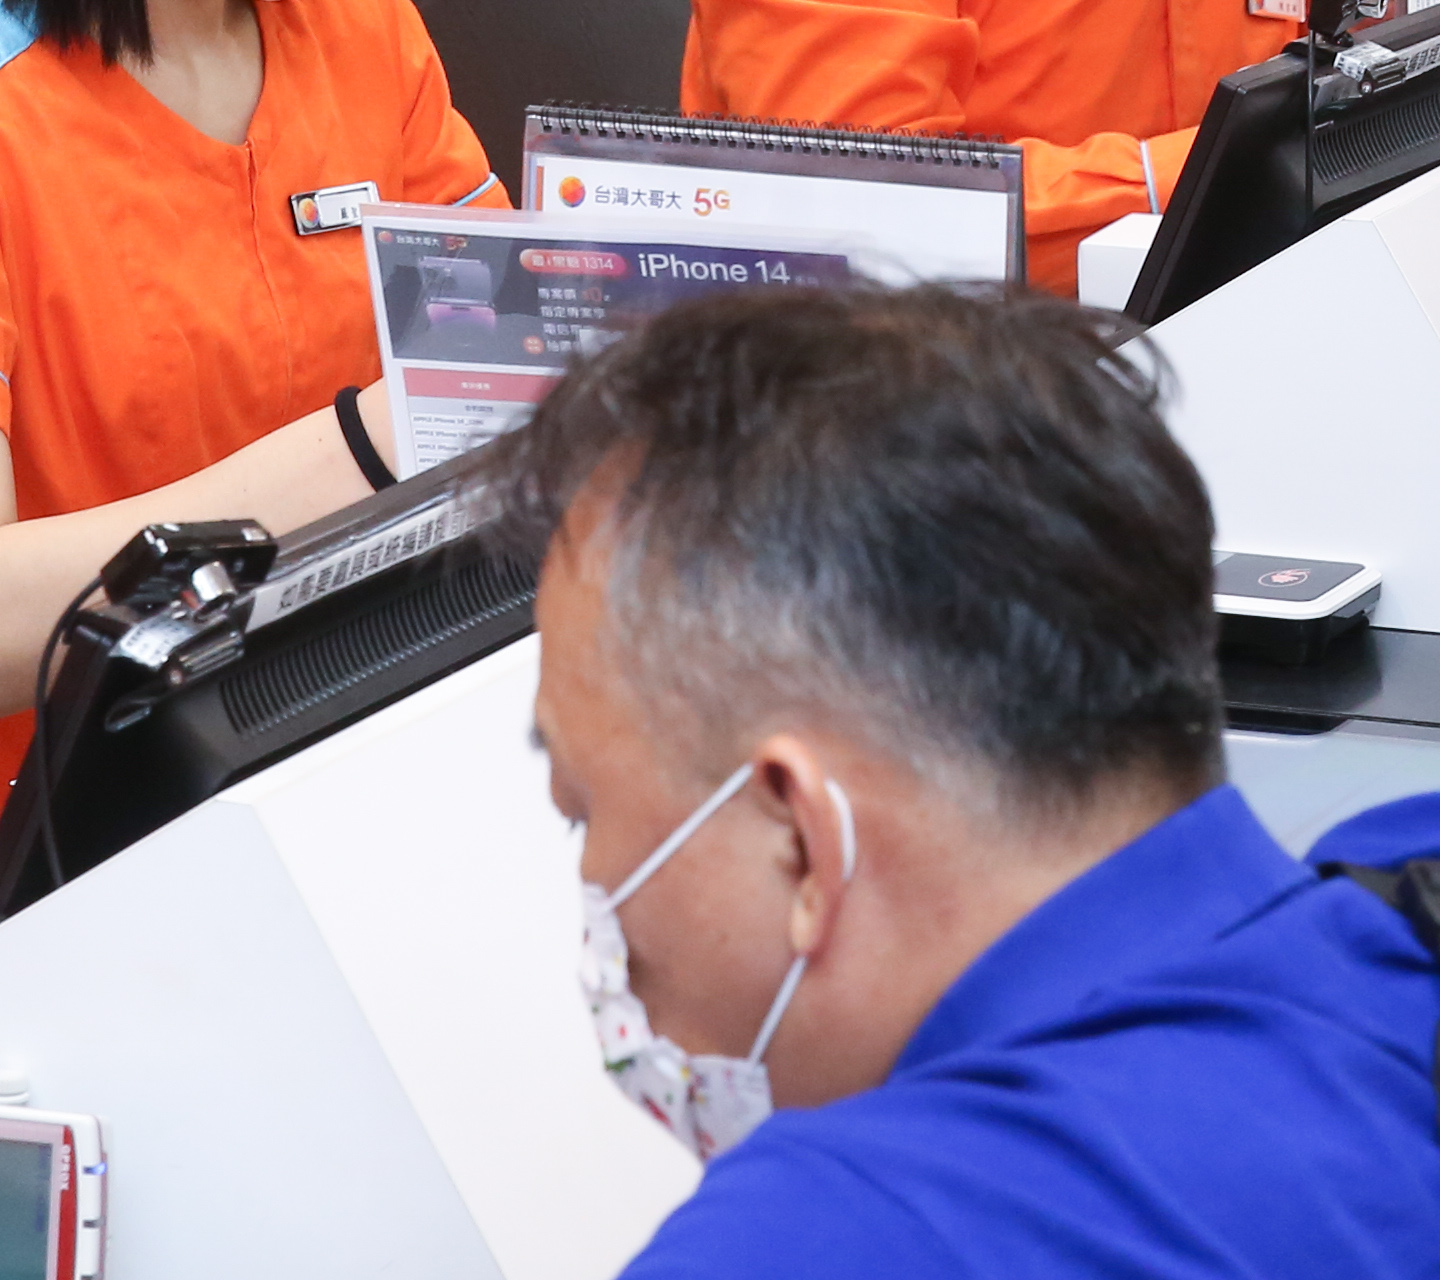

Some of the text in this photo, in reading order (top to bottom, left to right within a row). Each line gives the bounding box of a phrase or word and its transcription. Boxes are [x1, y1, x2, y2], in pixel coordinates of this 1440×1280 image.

[594, 184, 730, 216] 台灣大哥大 5G
[582, 256, 614, 270] 1314
[638, 253, 748, 283] iPhone
[754, 260, 790, 285] 14
